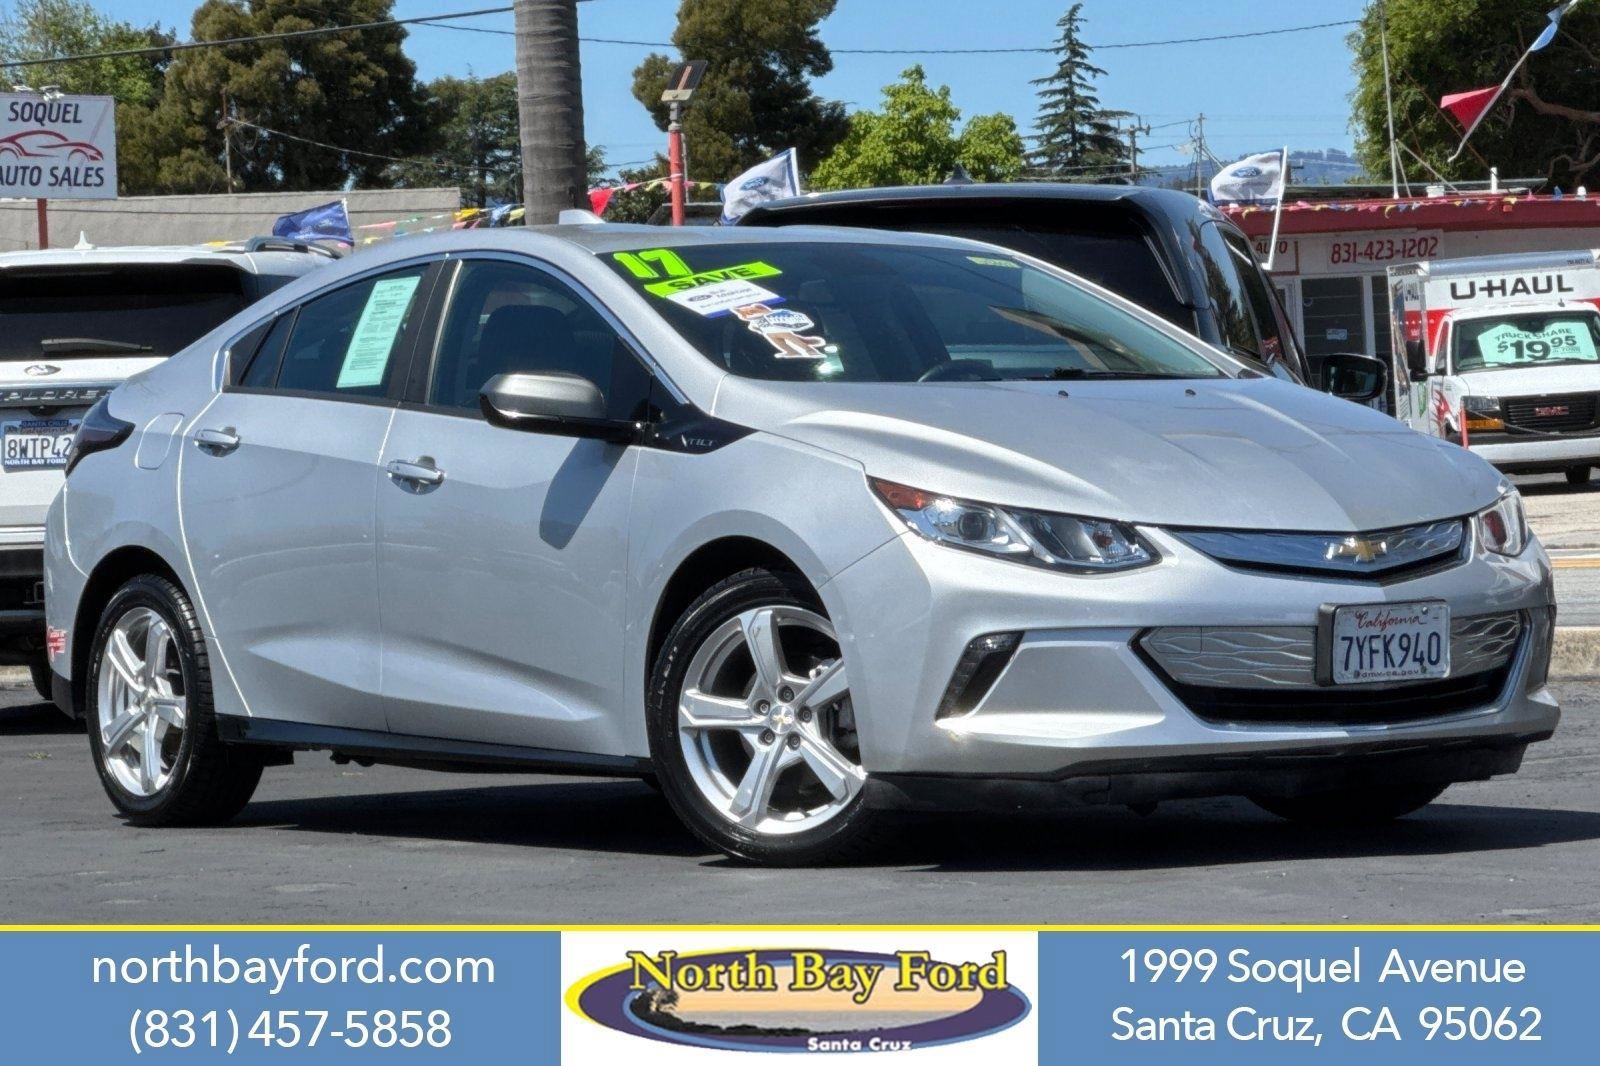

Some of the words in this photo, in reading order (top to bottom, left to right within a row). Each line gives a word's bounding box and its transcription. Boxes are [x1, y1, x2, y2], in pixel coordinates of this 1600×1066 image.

[8, 101, 82, 127] SOQUEL
[48, 166, 104, 187] SALES
[1256, 240, 1288, 254] AUO
[1331, 236, 1438, 264] 831-423-1202
[613, 249, 693, 278] 17
[667, 267, 756, 290] SAVE
[1450, 274, 1574, 300] U-HAUL
[1495, 332, 1532, 341] TRUCK
[1534, 328, 1574, 339] SHARE
[1354, 609, 1427, 631] California
[1341, 631, 1440, 671] 7YFK940
